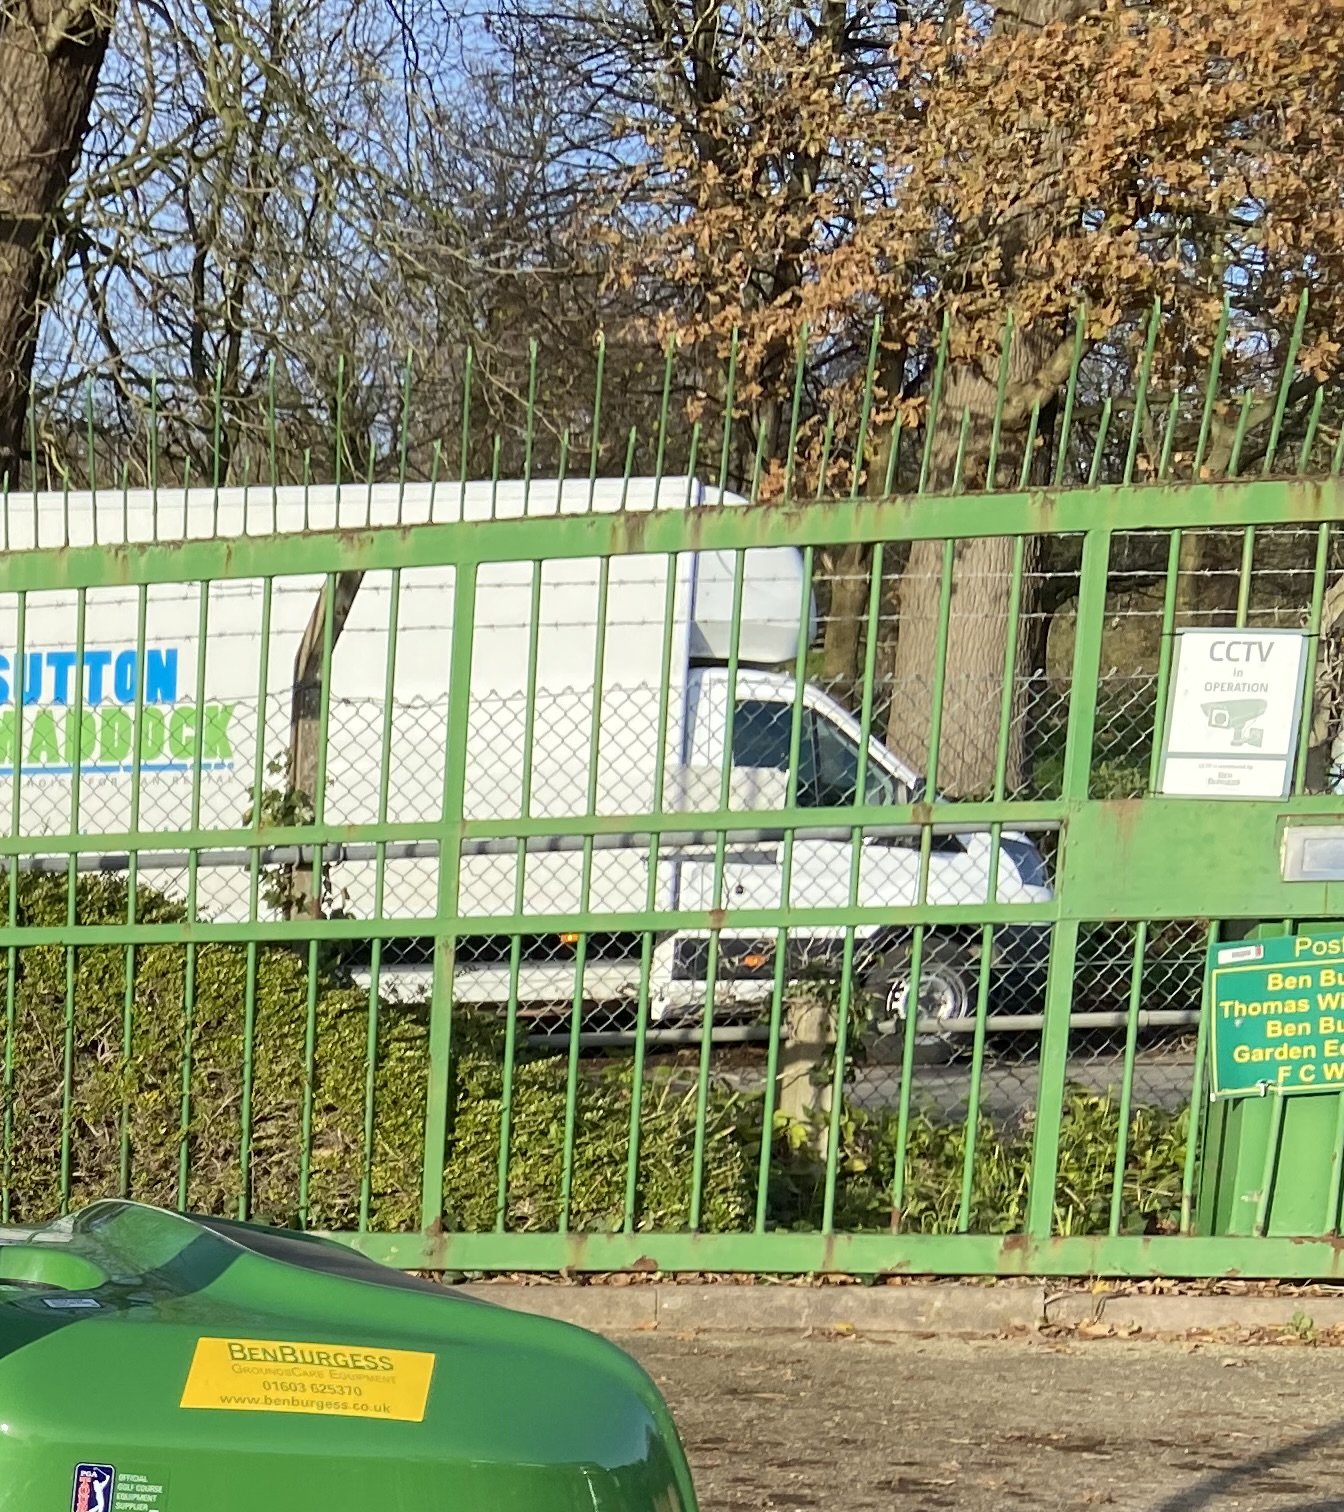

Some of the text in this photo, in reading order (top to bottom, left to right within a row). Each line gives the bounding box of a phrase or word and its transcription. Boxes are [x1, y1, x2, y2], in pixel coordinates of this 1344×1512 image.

[1209, 641, 1274, 662] CCTV
[1204, 682, 1269, 693] OPERATION
[1267, 973, 1312, 991] Ben
[1219, 998, 1310, 1019] Thomas
[1266, 1019, 1312, 1038] Ben
[1233, 1042, 1317, 1063] Garden
[1277, 1065, 1293, 1084] F
[1299, 1064, 1317, 1082] C
[329, 1369, 398, 1385] EQUIPMENT
[262, 1380, 363, 1397] 01603 625370
[220, 1394, 392, 1414] www.benburgess.co.uk
[80, 1470, 98, 1478] PGA
[118, 1473, 149, 1483] OFFICIAL
[116, 1482, 163, 1493] GOLF COURSE
[116, 1492, 158, 1502] EQUIPMENT
[115, 1501, 149, 1511] SUPPLIER
